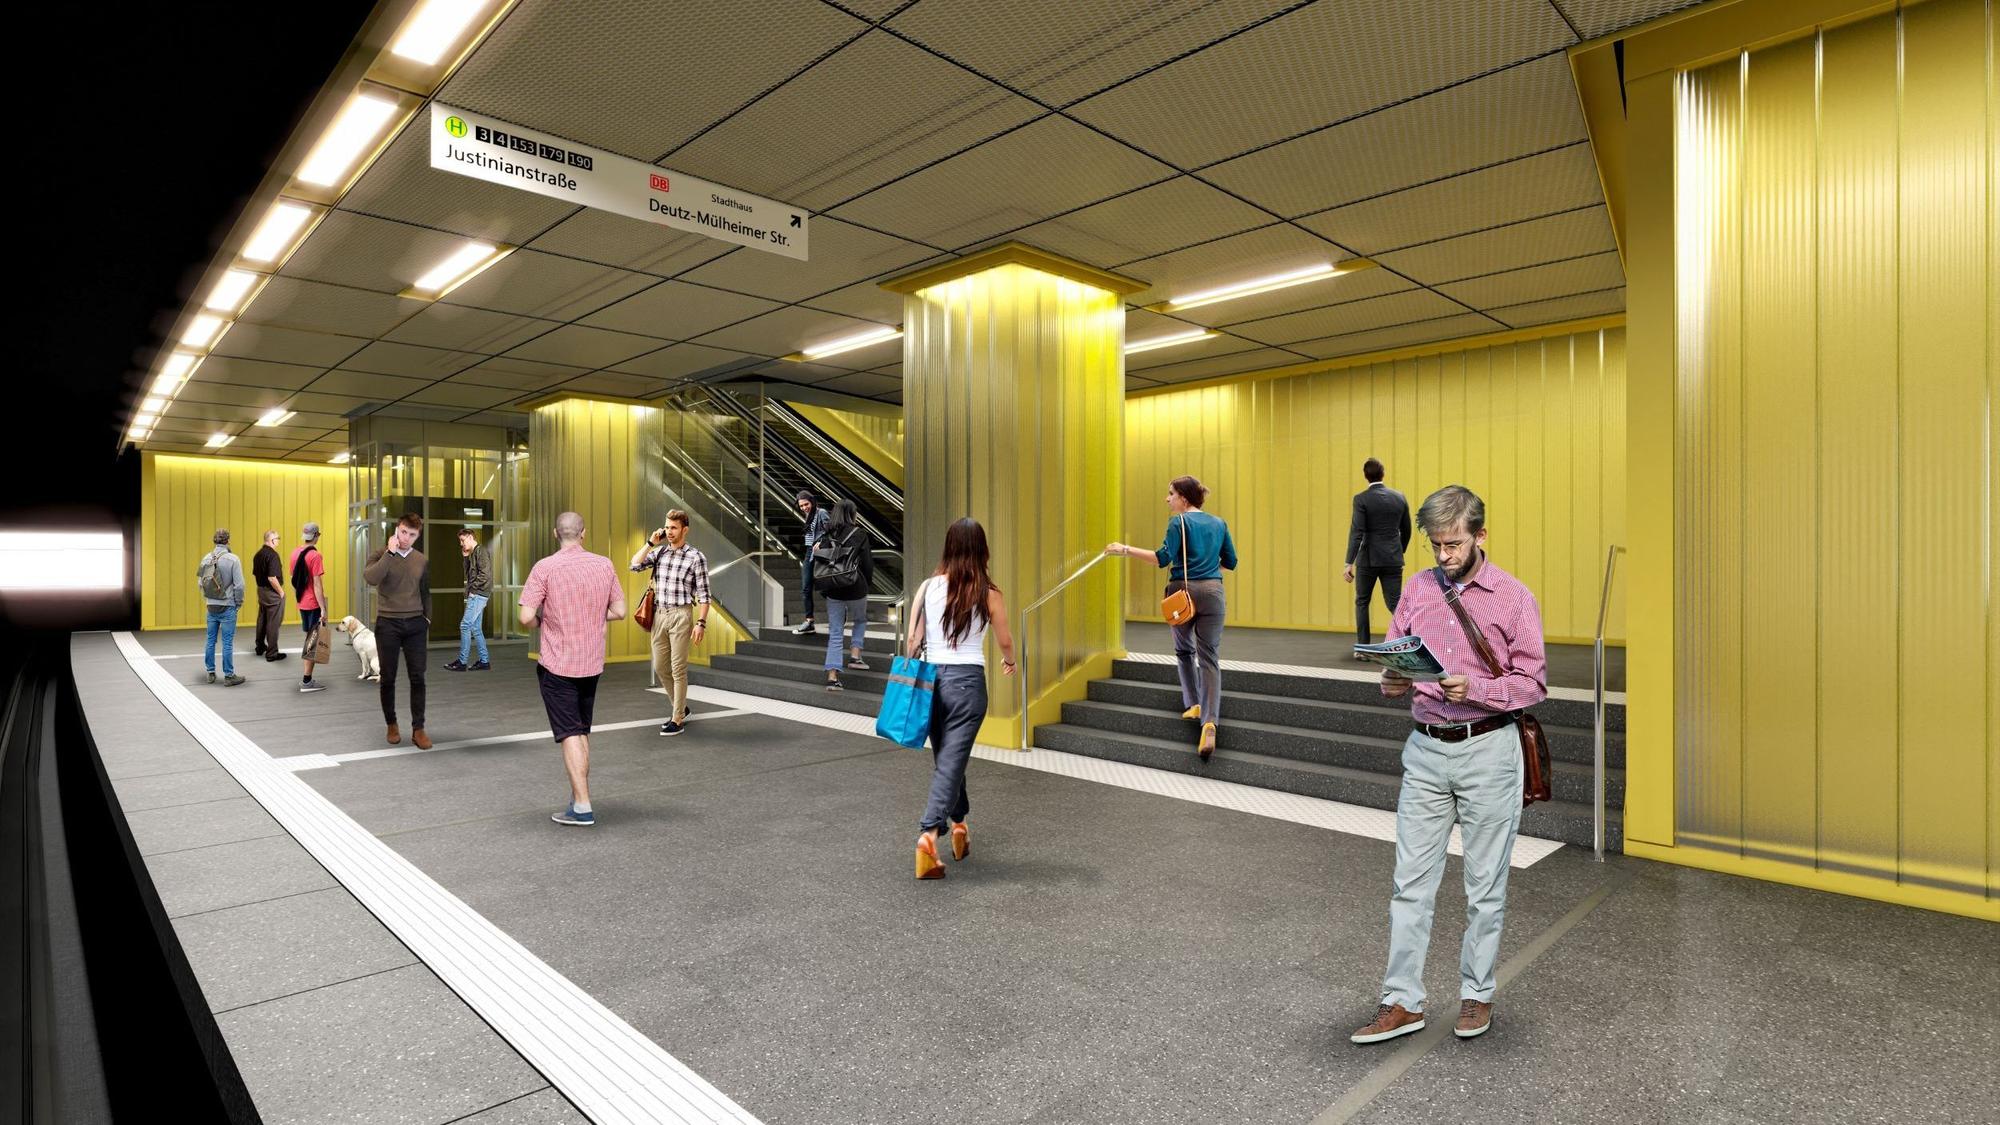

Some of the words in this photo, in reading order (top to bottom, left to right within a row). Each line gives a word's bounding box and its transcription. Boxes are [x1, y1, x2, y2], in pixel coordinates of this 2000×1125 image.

[450, 119, 463, 134] H
[512, 138, 535, 154] 153
[541, 146, 564, 161] 179
[569, 154, 591, 169] 190
[445, 144, 577, 191] Justinianstraße
[651, 176, 668, 190] DB
[711, 194, 753, 213] Stadthaus
[649, 198, 766, 240] Deutz-Mülheimer
[770, 230, 790, 247] Str.
